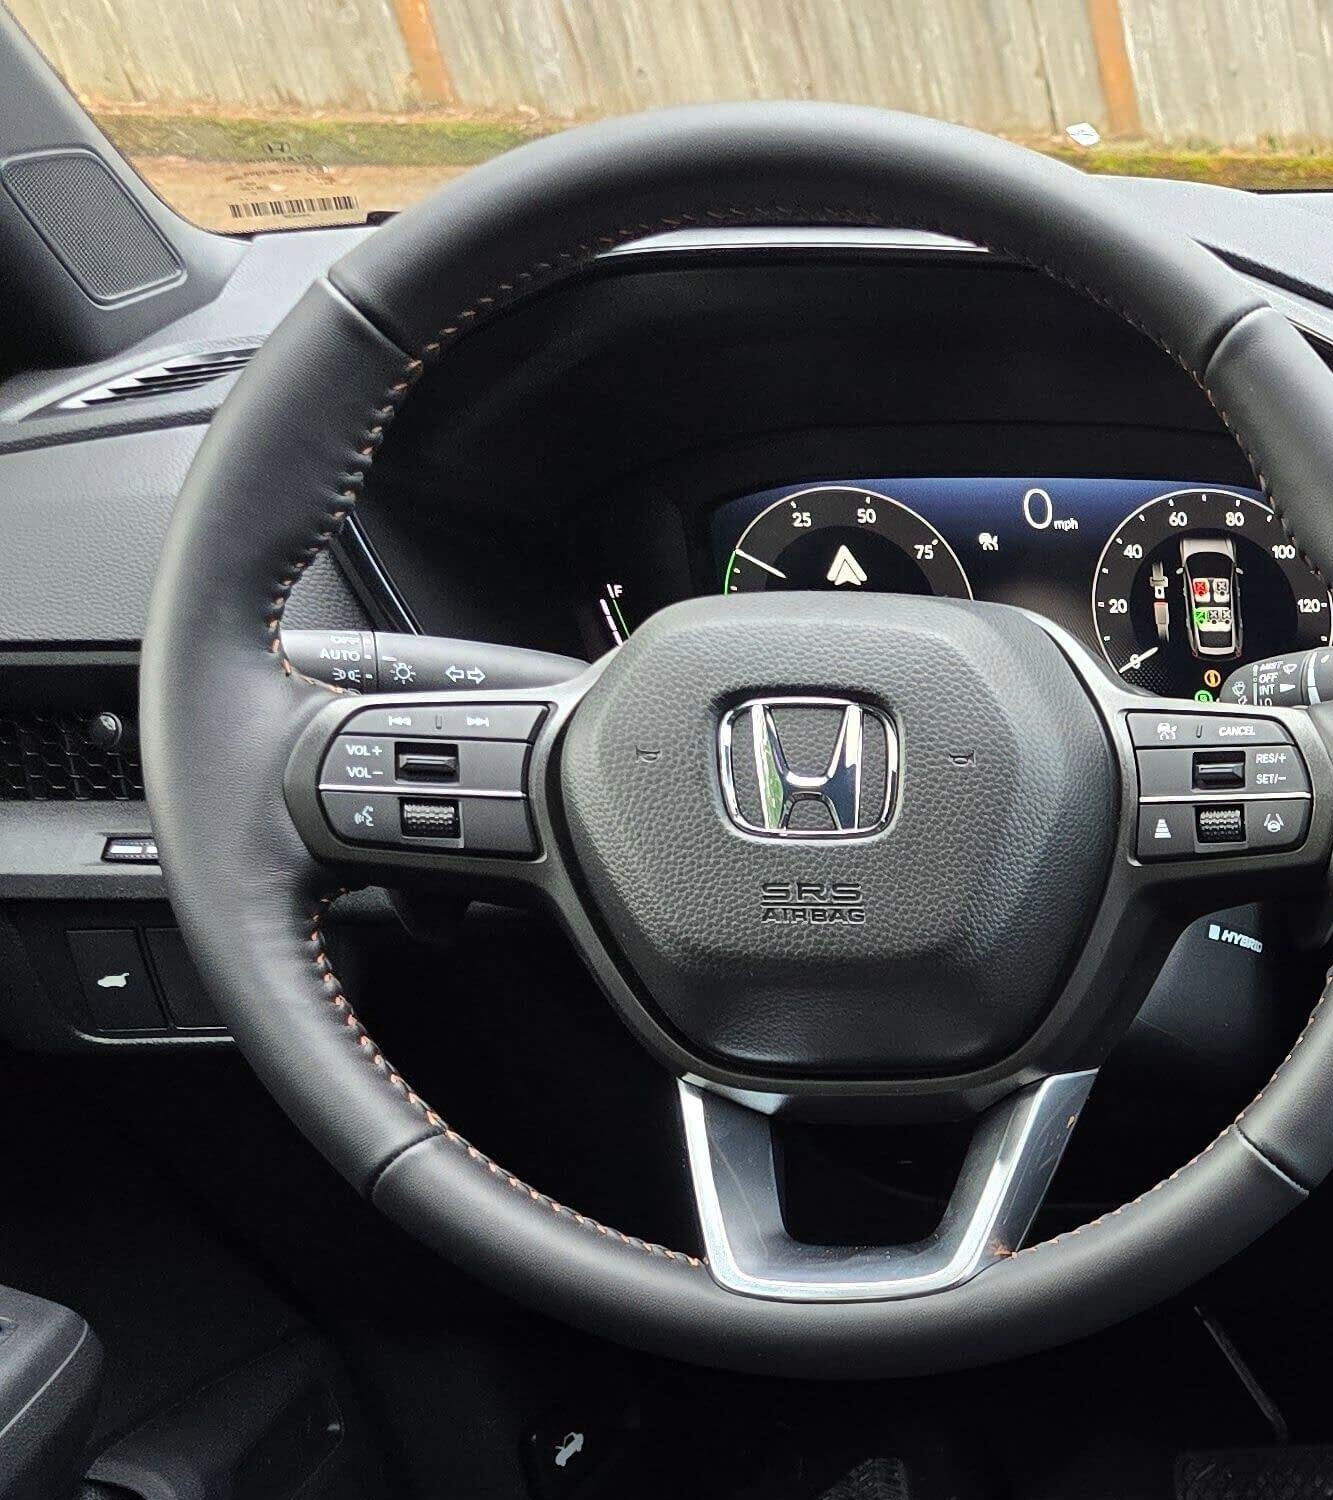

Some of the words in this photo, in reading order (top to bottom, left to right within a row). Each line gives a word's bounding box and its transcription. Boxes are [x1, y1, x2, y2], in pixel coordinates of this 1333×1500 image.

[857, 508, 877, 524] 50
[1023, 488, 1052, 530] 0
[792, 512, 812, 528] 25
[1053, 518, 1079, 531] mph
[1168, 511, 1188, 527] 60
[1225, 512, 1245, 527] 80
[914, 545, 935, 560] 75
[1123, 544, 1143, 559] 40
[1272, 545, 1295, 560] 100
[613, 585, 623, 598] F
[1108, 599, 1128, 614] 20
[1297, 599, 1321, 614] 120
[320, 648, 361, 661] AUTO
[1259, 673, 1278, 684] OFF
[1259, 684, 1276, 696] INT
[1218, 725, 1256, 737] CANCEL
[761, 882, 862, 903] SRS
[760, 907, 865, 925] AIRBAG
[1221, 929, 1263, 953] HYBRID
